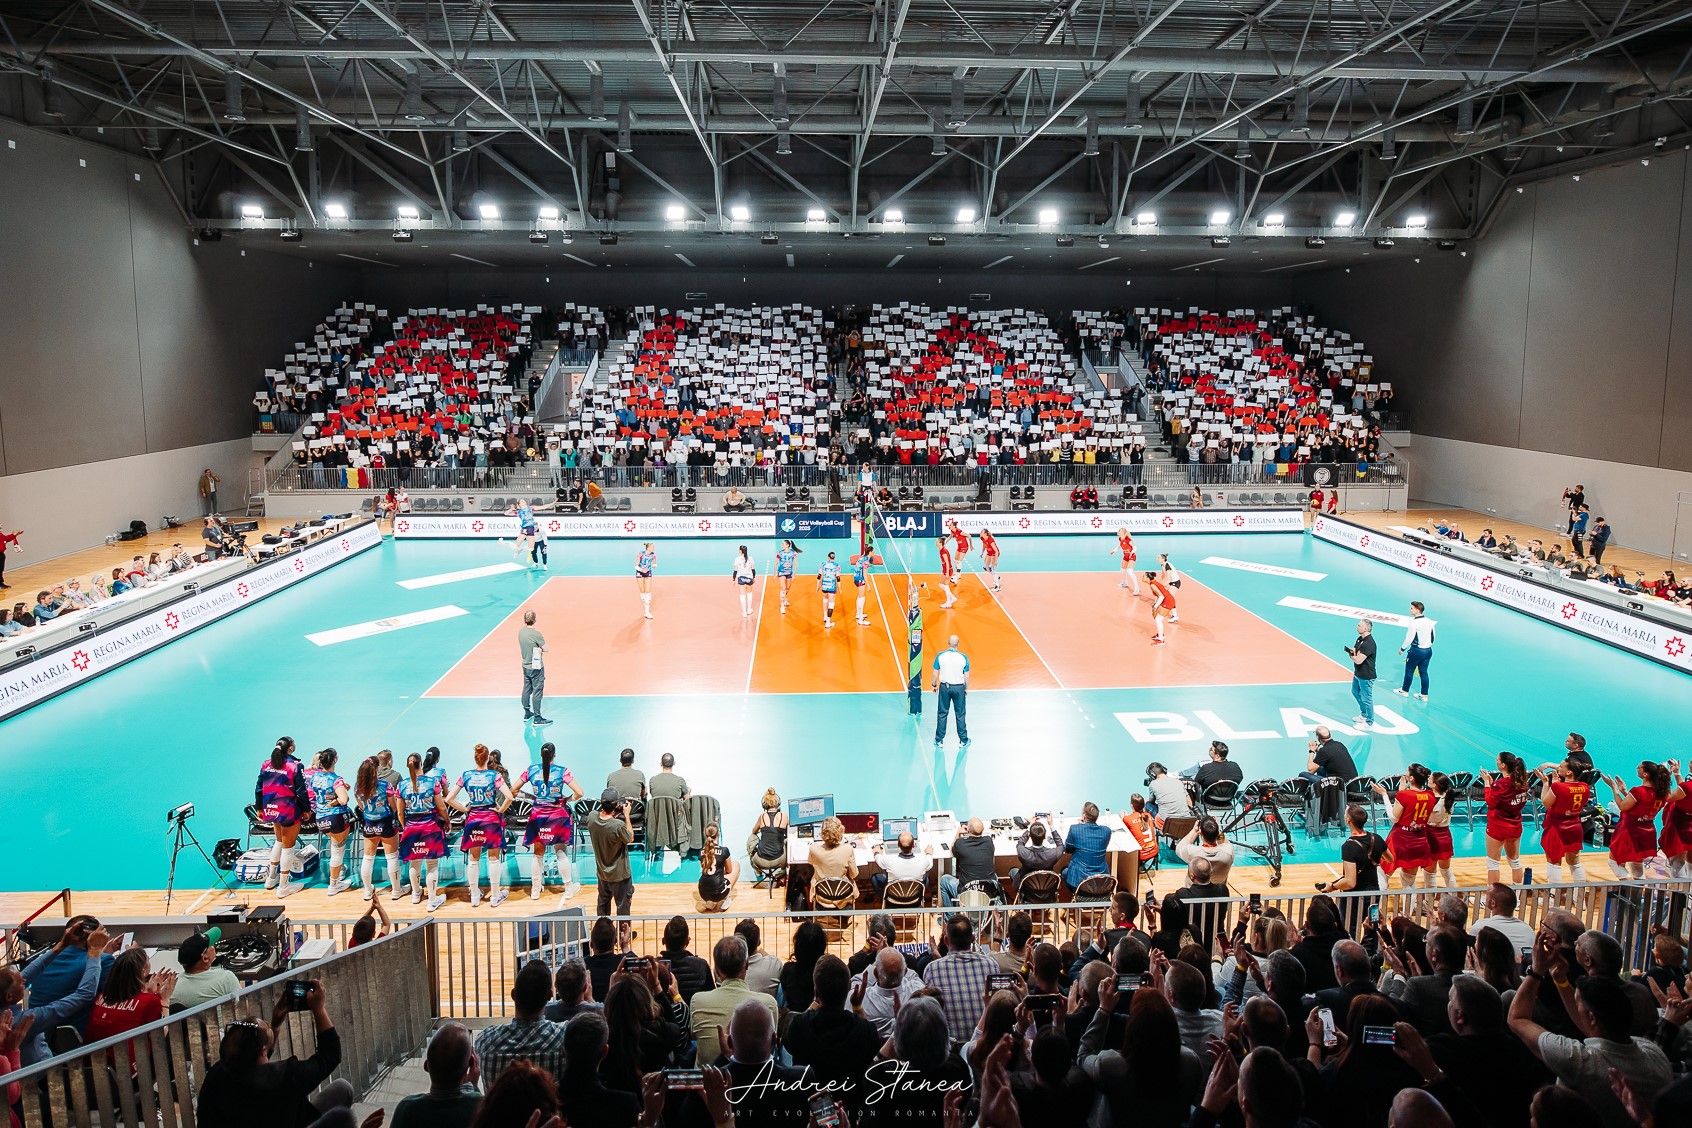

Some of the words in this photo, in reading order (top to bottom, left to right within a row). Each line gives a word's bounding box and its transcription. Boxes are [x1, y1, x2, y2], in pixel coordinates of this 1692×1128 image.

[885, 517, 927, 531] BLAJ
[305, 553, 324, 566] REGINA
[324, 545, 341, 557] MARIA
[1371, 540, 1392, 554] REGINA
[1393, 549, 1413, 562] MARIA
[250, 573, 274, 590] REGINA
[274, 566, 293, 580] MARIA
[1428, 560, 1453, 575] REGINA
[1454, 569, 1477, 583] MARIA
[181, 602, 211, 620] REGINA
[212, 592, 235, 606] MARIA
[1495, 582, 1527, 600] REGINA
[1527, 593, 1556, 610] MARIA
[1580, 611, 1619, 632] REGINA
[1621, 625, 1657, 645] MARIA
[93, 636, 131, 659] REGINA
[132, 623, 162, 642] MARIA
[31, 663, 70, 686] MARIA
[1112, 704, 1421, 743] BLAJ
[366, 798, 373, 812] 6
[410, 795, 423, 809] 24
[473, 788, 484, 802] 16
[1572, 793, 1583, 811] 8
[866, 815, 875, 828] 2
[1413, 802, 1428, 821] 14
[469, 834, 487, 843] Volley
[411, 847, 430, 855] Volley
[117, 998, 140, 1011] BLAJ
